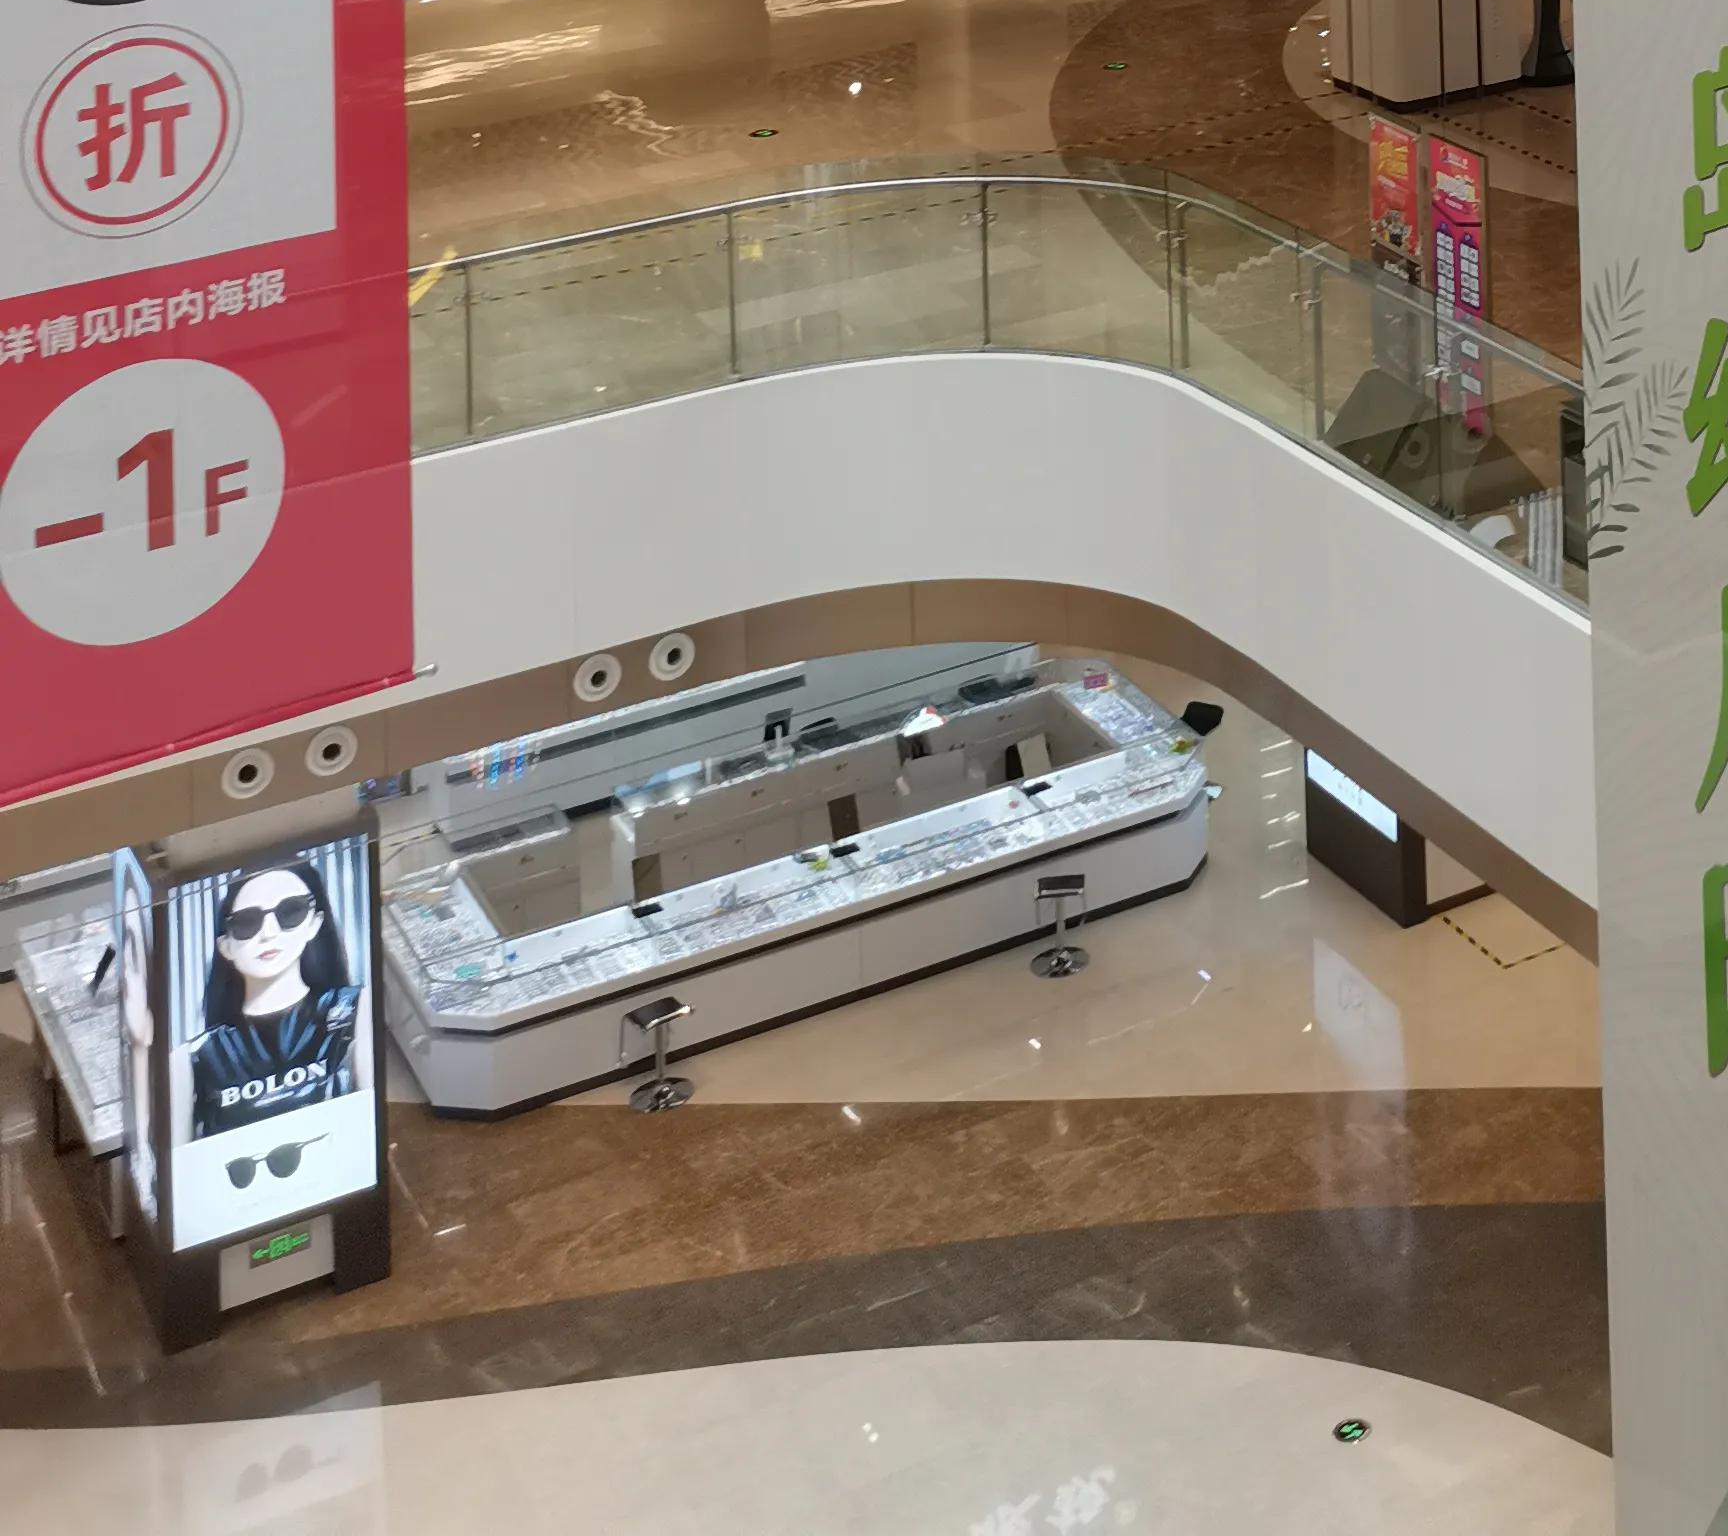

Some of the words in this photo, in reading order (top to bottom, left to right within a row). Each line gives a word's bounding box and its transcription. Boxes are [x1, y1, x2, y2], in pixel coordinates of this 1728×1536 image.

[76, 72, 191, 193] 折
[0, 268, 288, 367] 详情见店内海报
[219, 1058, 329, 1110] BOLON
